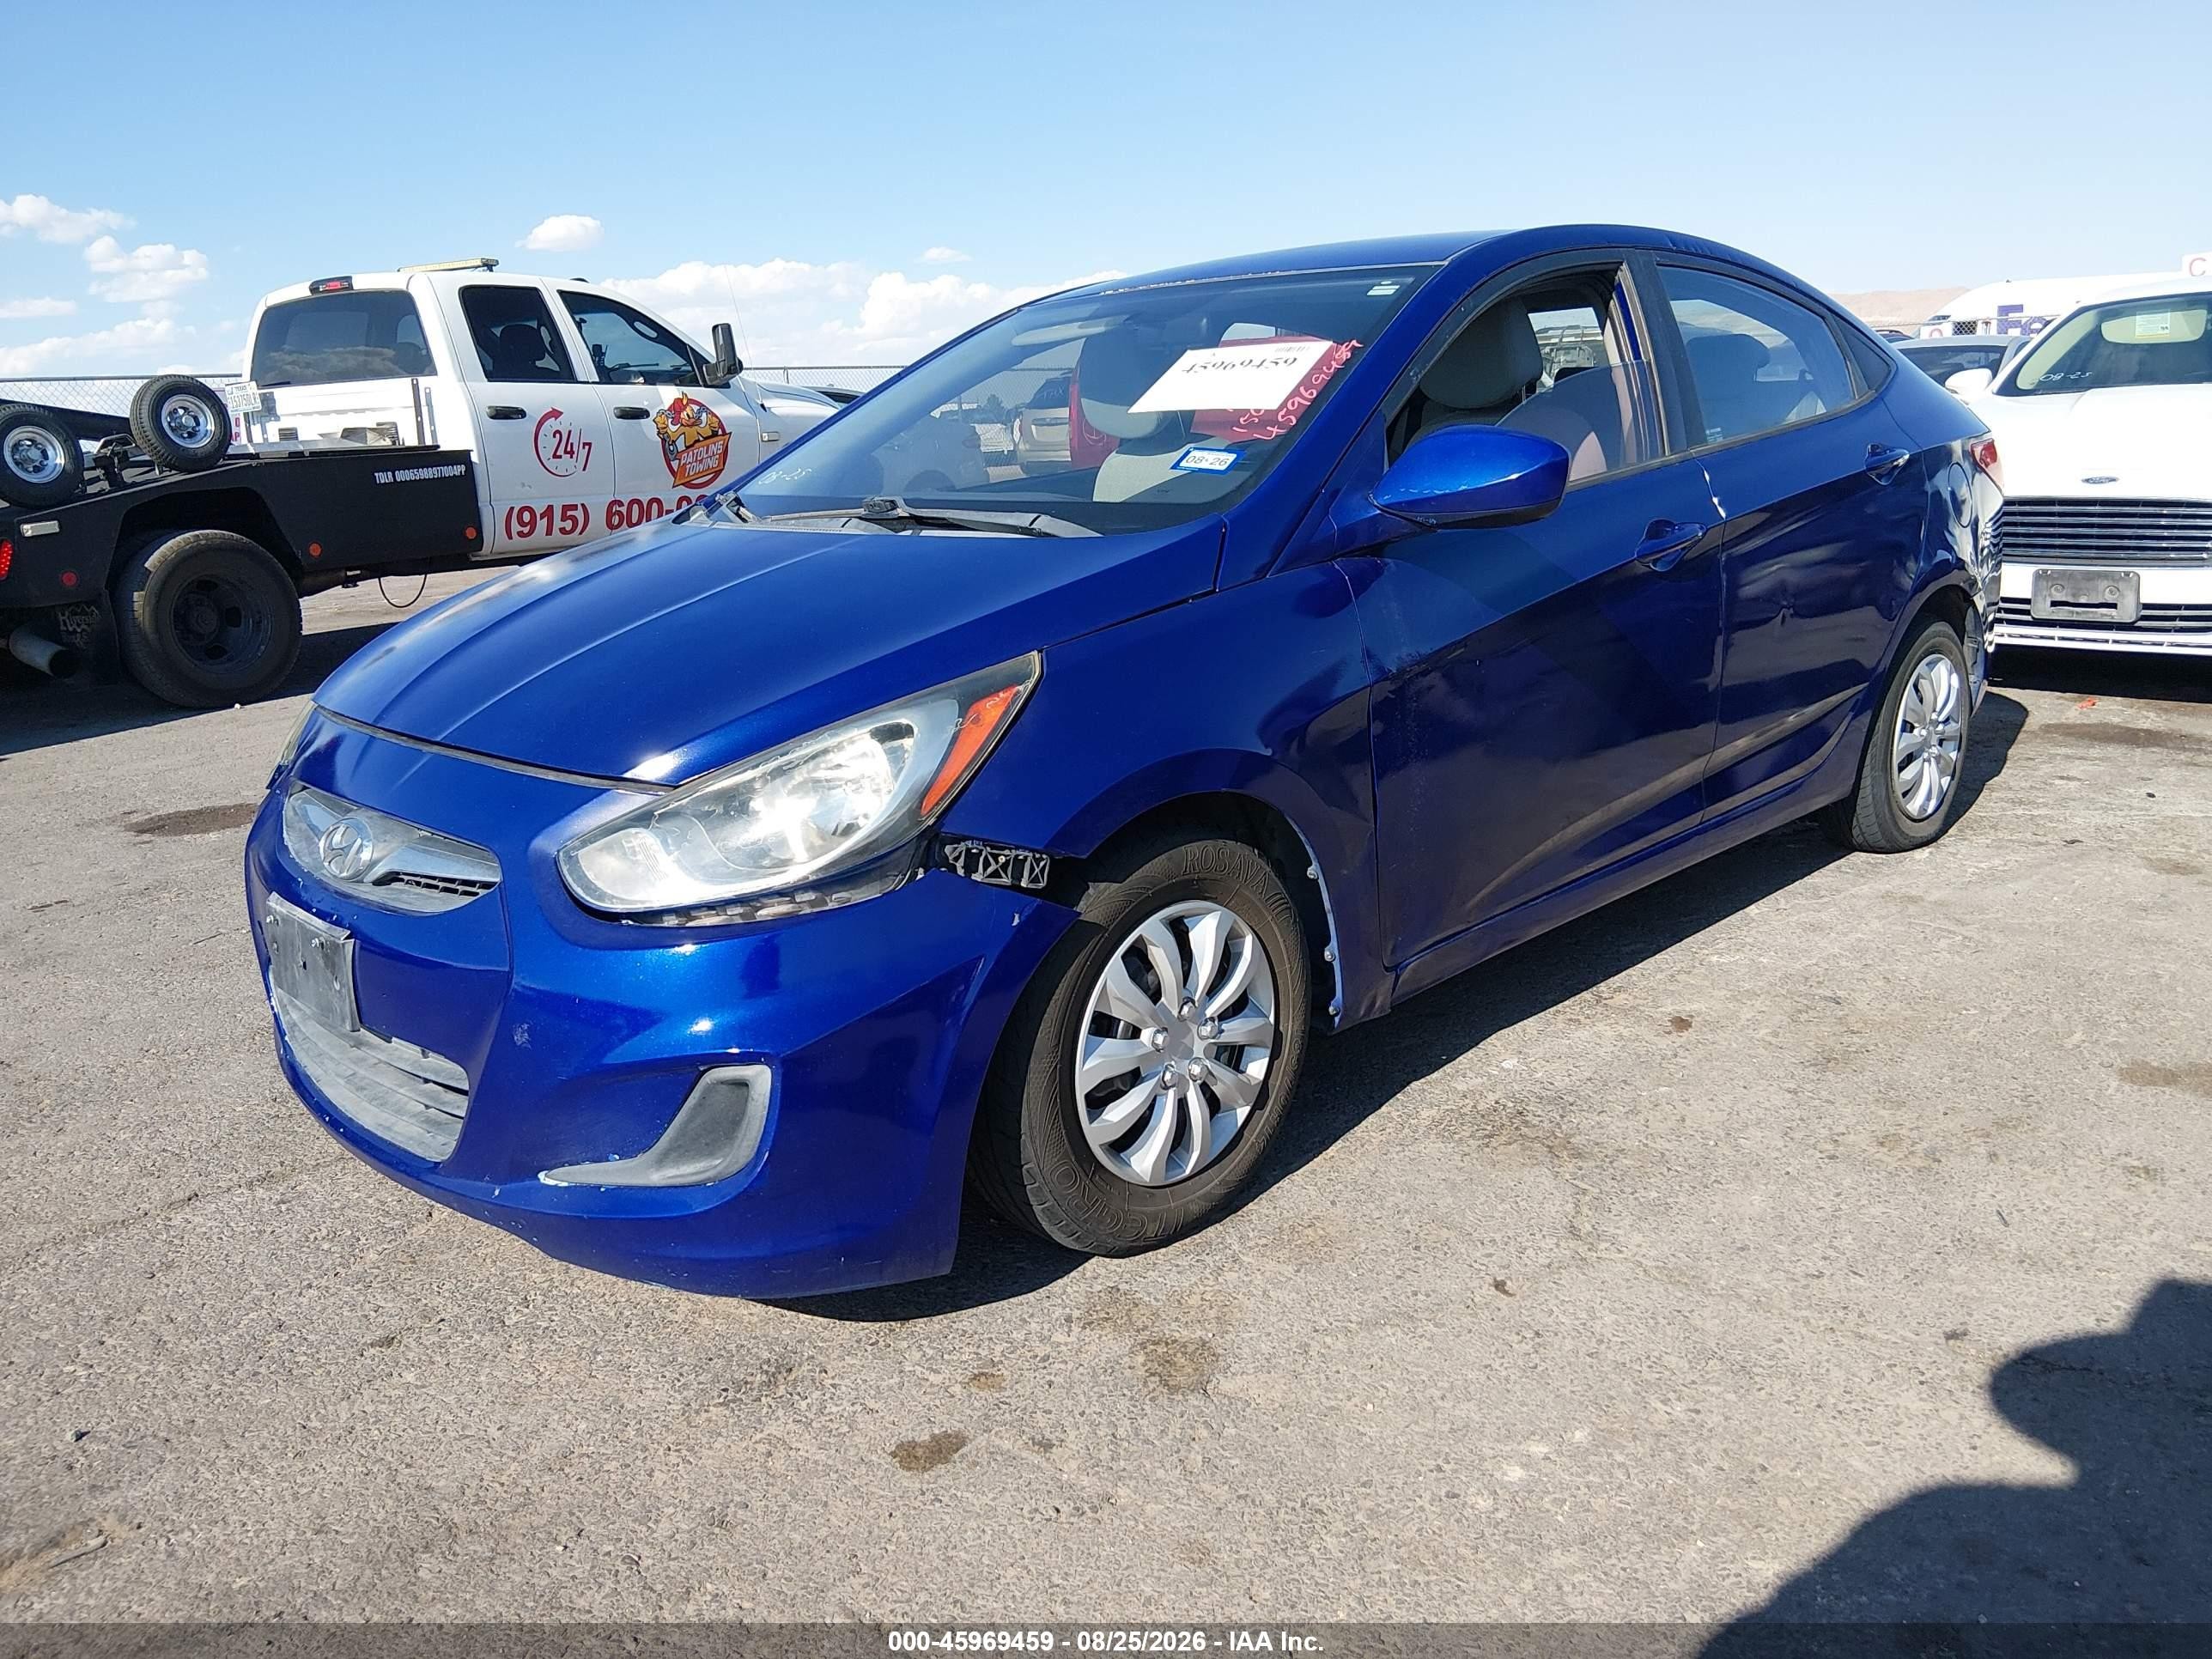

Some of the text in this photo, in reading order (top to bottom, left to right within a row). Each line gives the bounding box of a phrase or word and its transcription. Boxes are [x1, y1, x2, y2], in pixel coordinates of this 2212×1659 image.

[552, 428, 592, 471] 24/7
[681, 441, 724, 466] PATOLINS
[1208, 457, 1230, 466] 26
[374, 471, 393, 483] TDLR
[685, 455, 719, 477] TOWING
[504, 495, 709, 540] (915) 600-
[1182, 845, 1269, 899] ROSAVA
